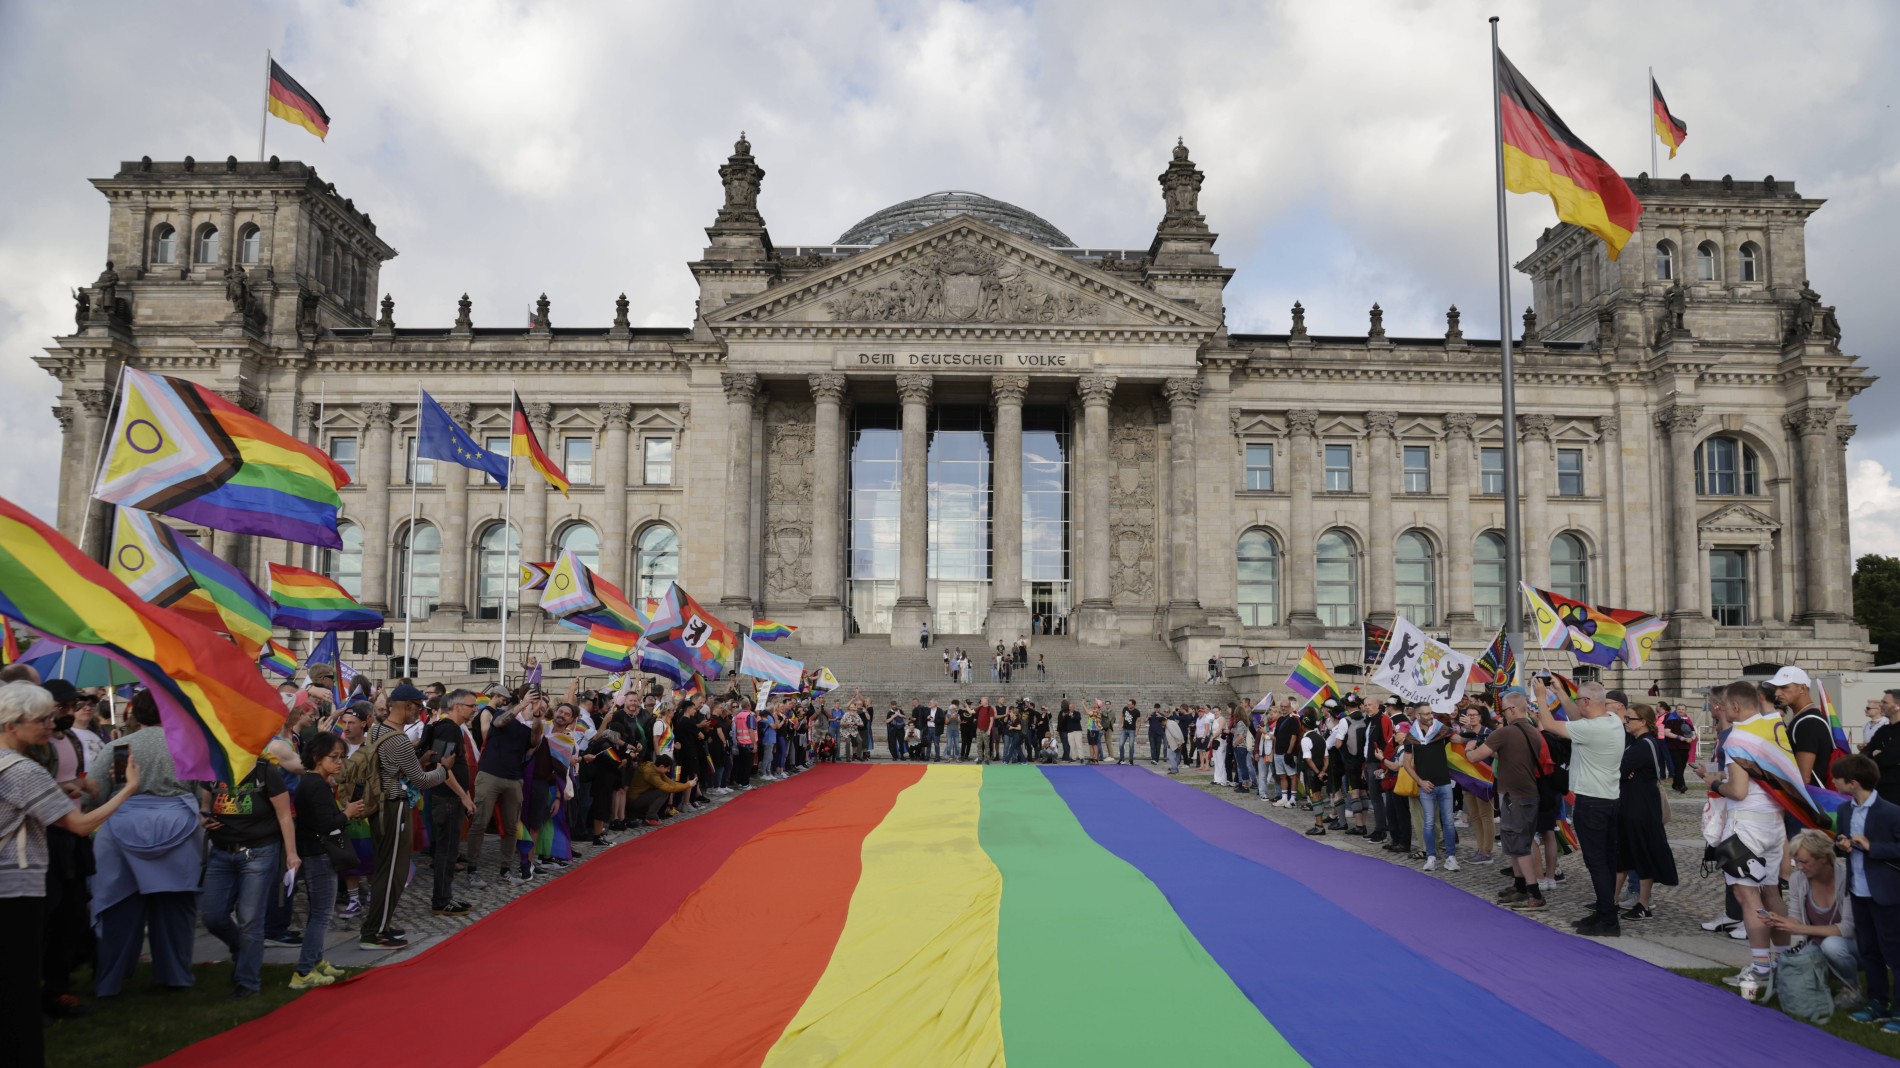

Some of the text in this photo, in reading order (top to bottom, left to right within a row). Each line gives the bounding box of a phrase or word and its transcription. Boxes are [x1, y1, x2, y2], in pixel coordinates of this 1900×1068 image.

[858, 353, 1066, 367] DEM DEUTSCHEN VOLKE
